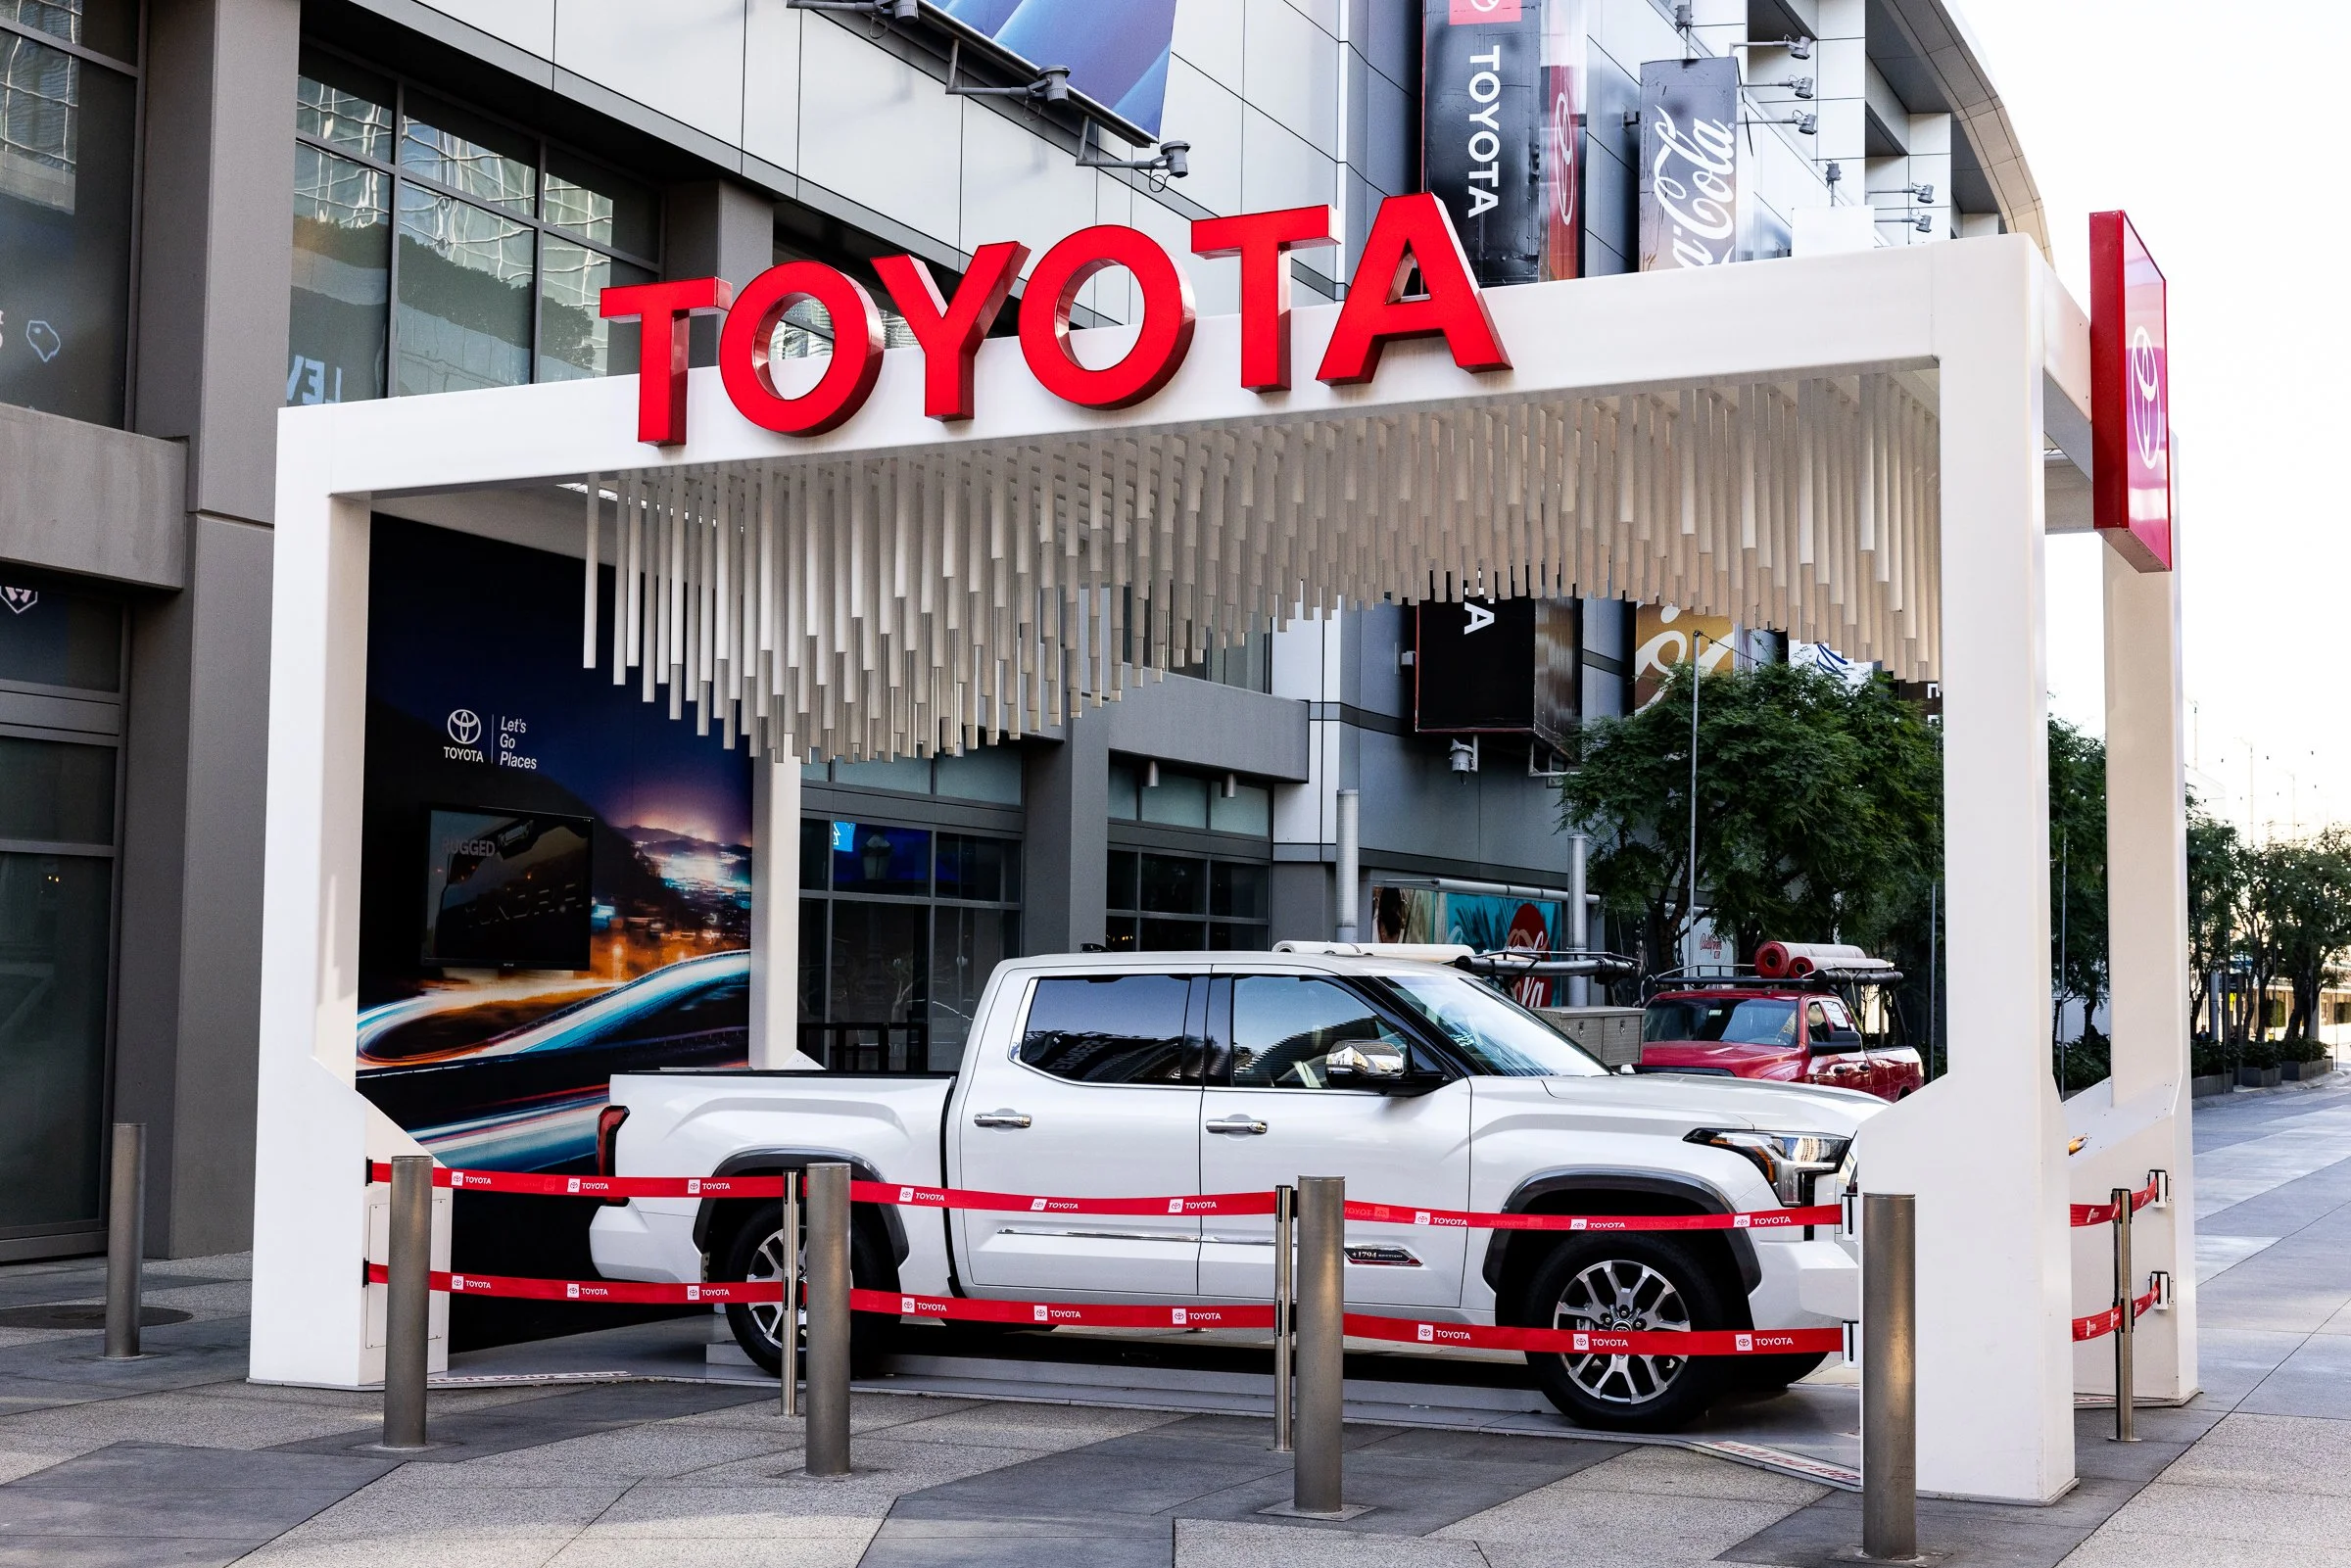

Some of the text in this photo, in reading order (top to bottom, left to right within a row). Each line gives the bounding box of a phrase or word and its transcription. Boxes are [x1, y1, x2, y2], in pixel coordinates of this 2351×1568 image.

[1467, 45, 1501, 218] TOYOTA
[600, 192, 1514, 447] TOYOTA
[501, 716, 527, 734] Let's
[500, 734, 516, 749] Go
[443, 746, 484, 763] TOYOTA
[500, 751, 538, 770] Places
[443, 839, 496, 857] RUGGED
[464, 1176, 492, 1185] TOYOTA
[701, 1181, 731, 1190] TOYOTA
[915, 1193, 945, 1202] TOYOTA
[1185, 1201, 1217, 1210] TOYOTA
[1433, 1217, 1467, 1226] TOYOTA
[1752, 1215, 1791, 1225] TOYOTA
[465, 1280, 492, 1289] TOYOTA
[581, 1287, 608, 1296] TOYOTA
[916, 1302, 947, 1311] TOYOTA
[1049, 1309, 1081, 1318] TOYOTA
[1436, 1329, 1471, 1340] TOYOTA
[1591, 1338, 1629, 1347] TOYOTA
[1754, 1337, 1794, 1346] TOYOTA
